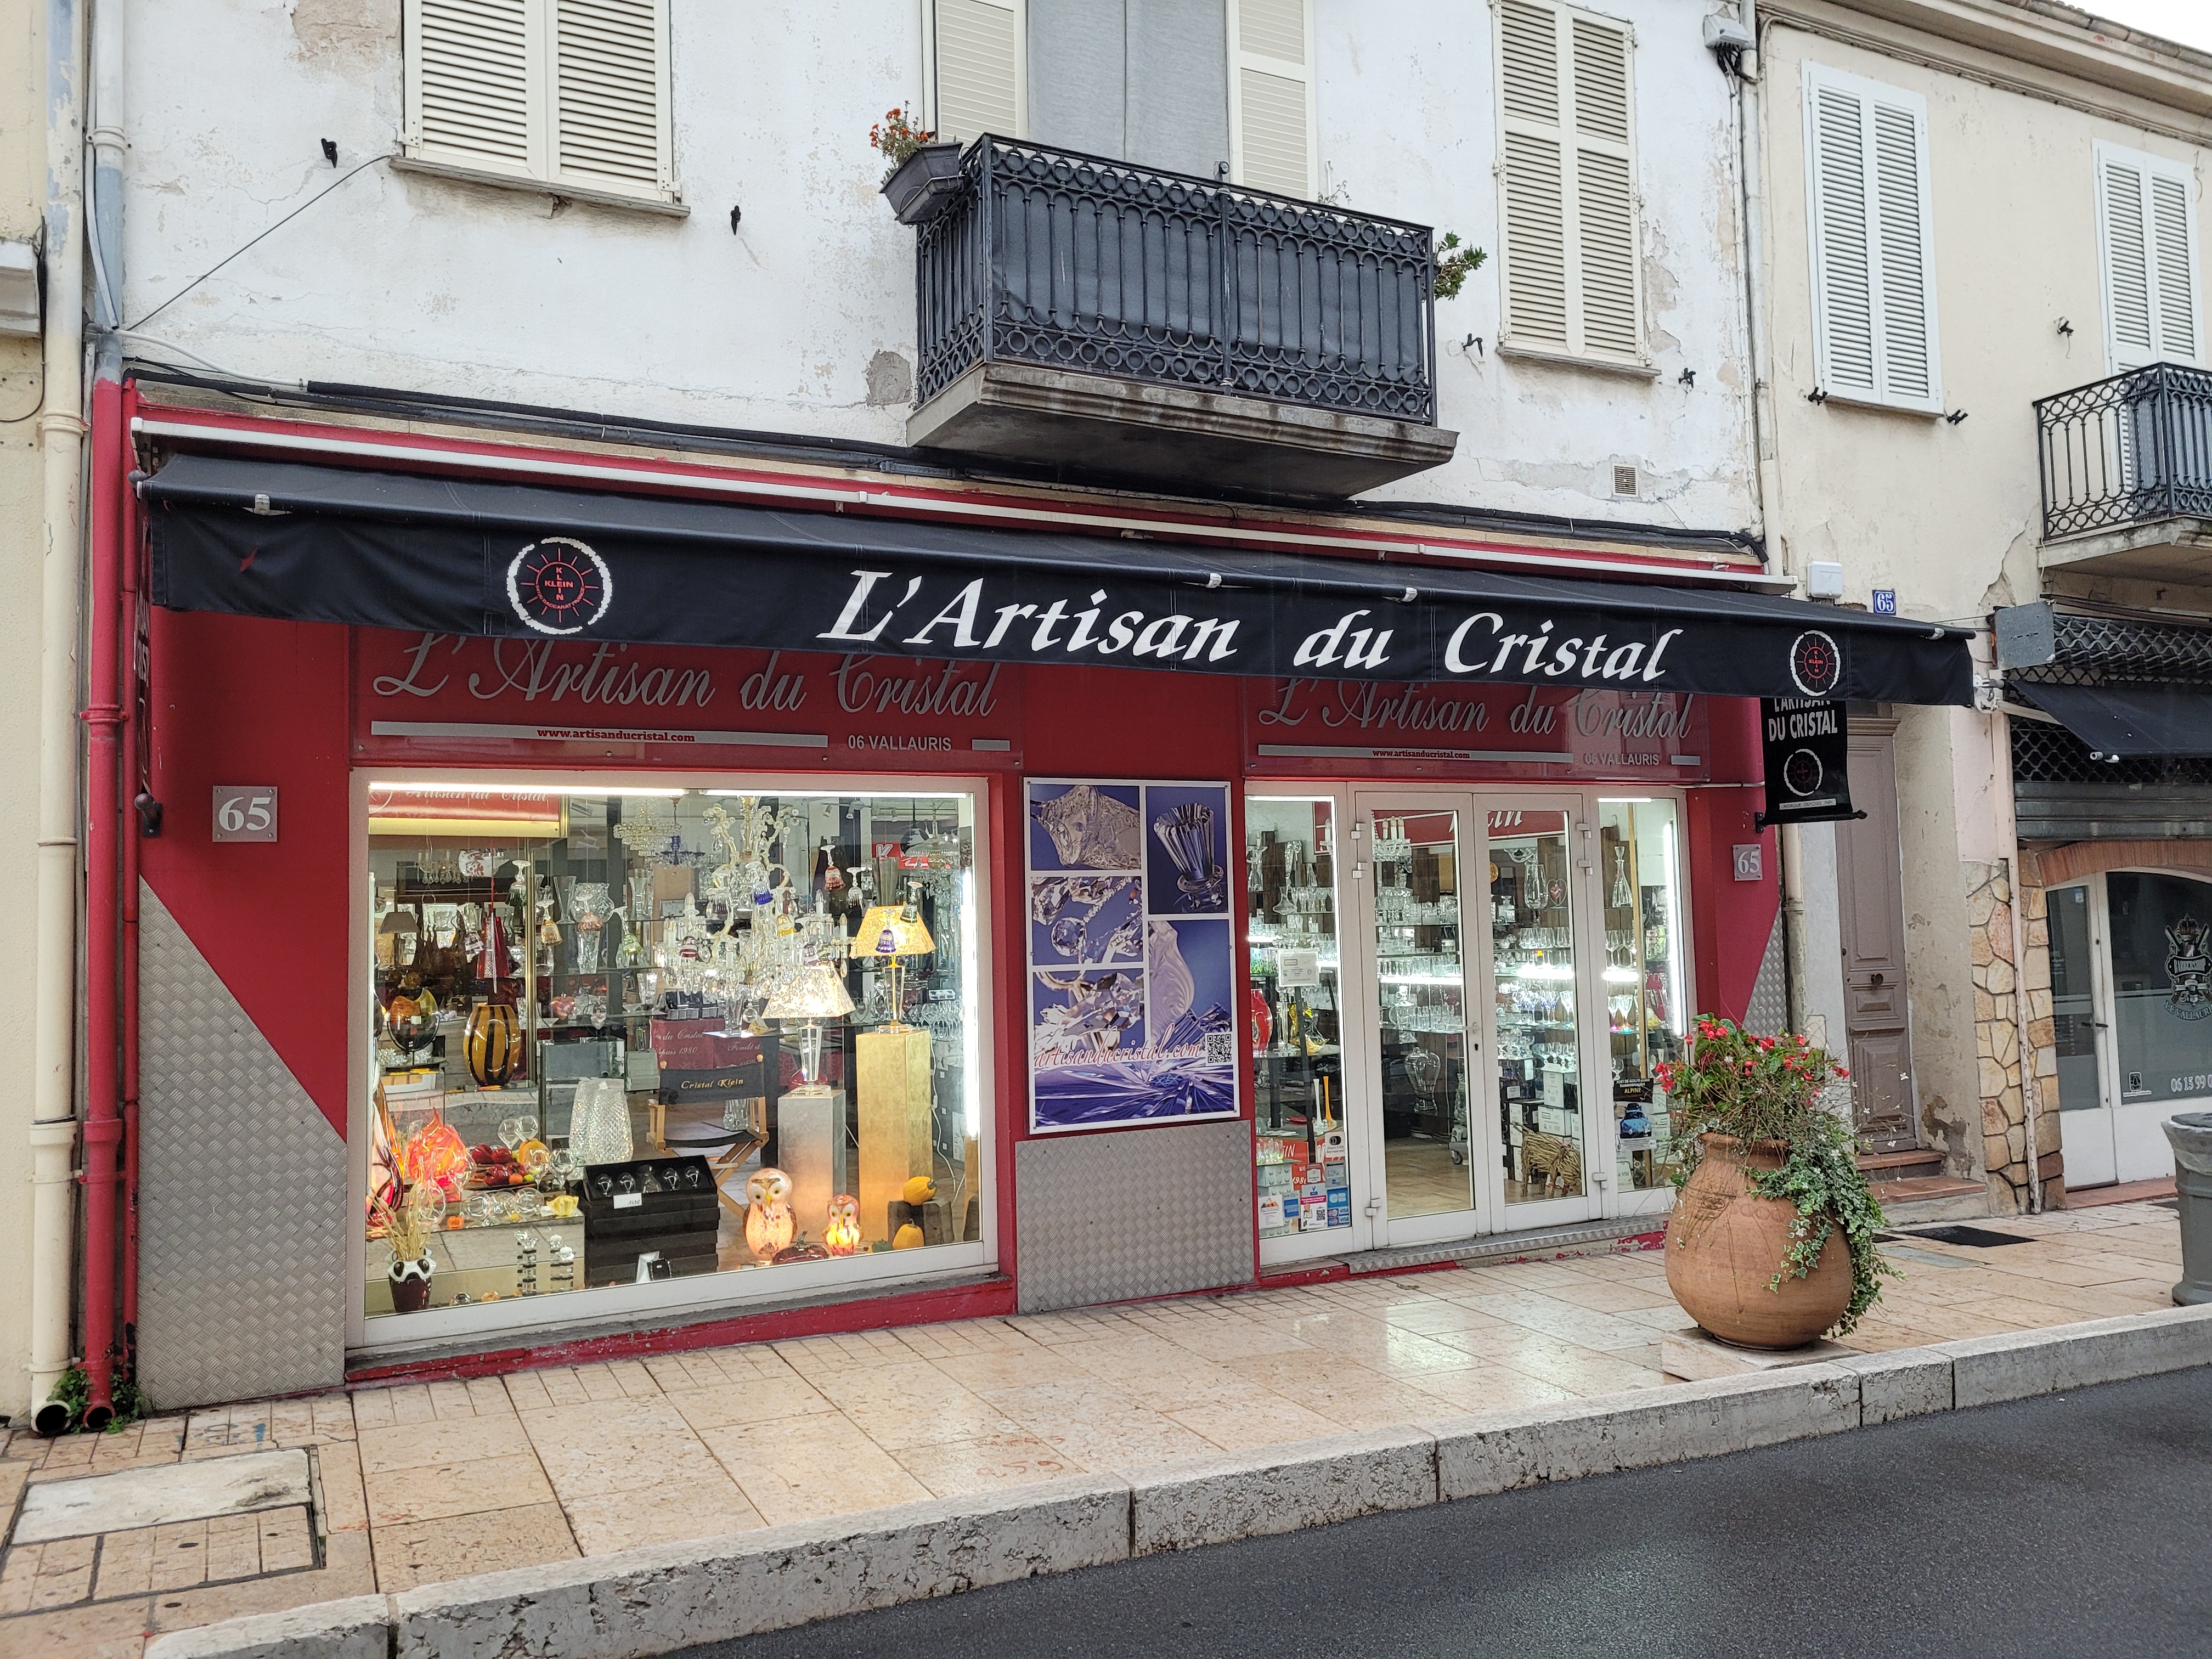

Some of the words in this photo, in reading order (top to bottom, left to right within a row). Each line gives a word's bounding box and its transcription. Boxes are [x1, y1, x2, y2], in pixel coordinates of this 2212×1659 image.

[544, 579, 573, 588] KLEIN
[1876, 594, 1894, 612] 65
[815, 570, 1241, 662] L'Artisan
[1293, 610, 1395, 669] du
[1444, 612, 1684, 682] Cristal
[740, 650, 807, 712] du
[829, 654, 1001, 717] Cristal
[1510, 686, 1557, 735] du
[1568, 689, 1694, 738] Cristal
[1768, 716, 1786, 742] DU
[1790, 709, 1838, 739] CRISTAL
[537, 730, 695, 742] www.artisanducristal.com
[848, 735, 865, 749] 06
[868, 736, 952, 752] VALLAURIS
[1372, 749, 1470, 759] www.artisanducristal.com
[1584, 753, 1597, 764] 06
[1601, 754, 1660, 766] VALLAURIS
[218, 797, 272, 832] 65
[1737, 851, 1760, 875] 65
[2164, 1000, 2175, 1014] LE
[2176, 1003, 2212, 1019] VALLAURI
[1034, 1023, 1201, 1067] artisanducristal.com
[681, 1080, 713, 1089] Cristal
[717, 1078, 743, 1088] Klein
[2171, 1077, 2182, 1092] 06
[2183, 1076, 2194, 1091] 15
[2195, 1075, 2206, 1090] 99
